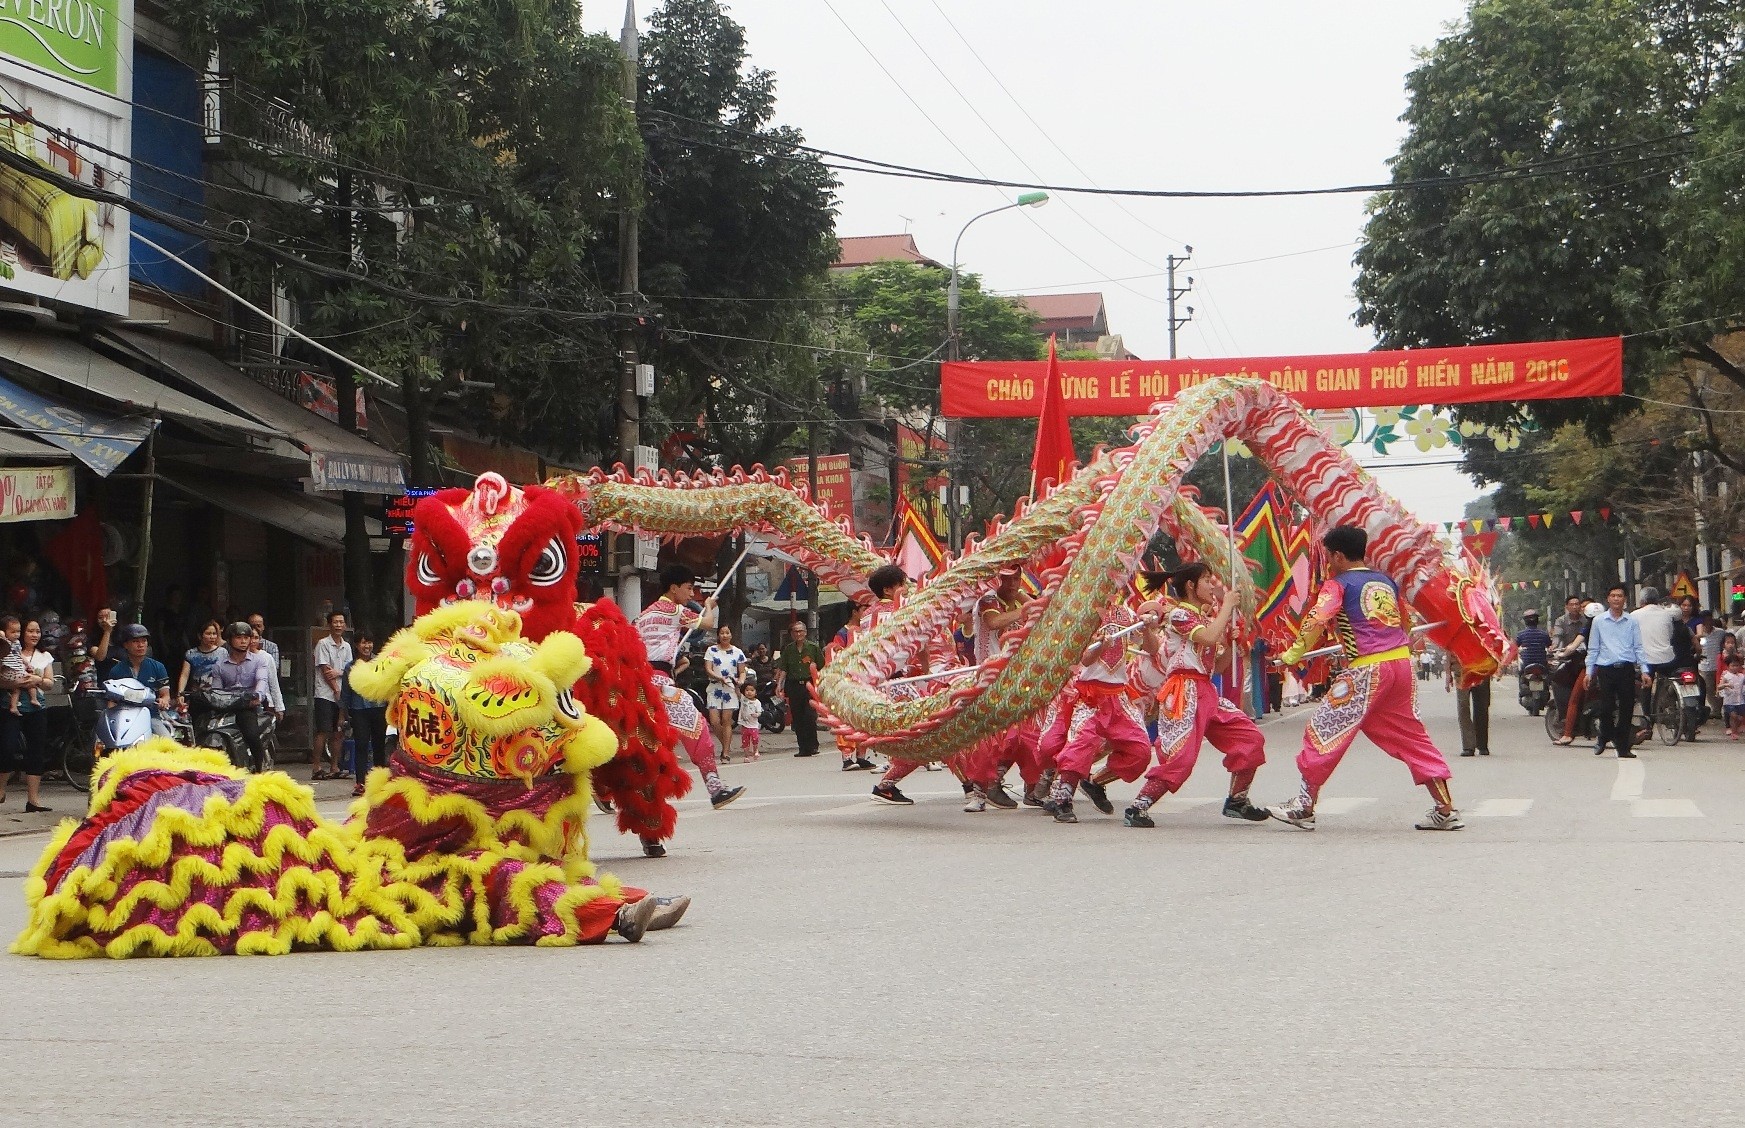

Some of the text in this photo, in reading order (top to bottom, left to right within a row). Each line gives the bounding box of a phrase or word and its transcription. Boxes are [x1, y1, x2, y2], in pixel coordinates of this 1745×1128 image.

[986, 374, 1034, 401] CHÀO
[1050, 372, 1099, 400] ỪNG
[1110, 369, 1134, 398] LỄ
[1139, 370, 1169, 400] HỘI
[1179, 368, 1215, 392] VĂ
[1269, 366, 1308, 392] DÂN
[1316, 368, 1360, 391] GIAN
[1370, 360, 1408, 389] PHỐ
[1417, 358, 1460, 387] HIẾN
[1471, 357, 1515, 385] NĂM
